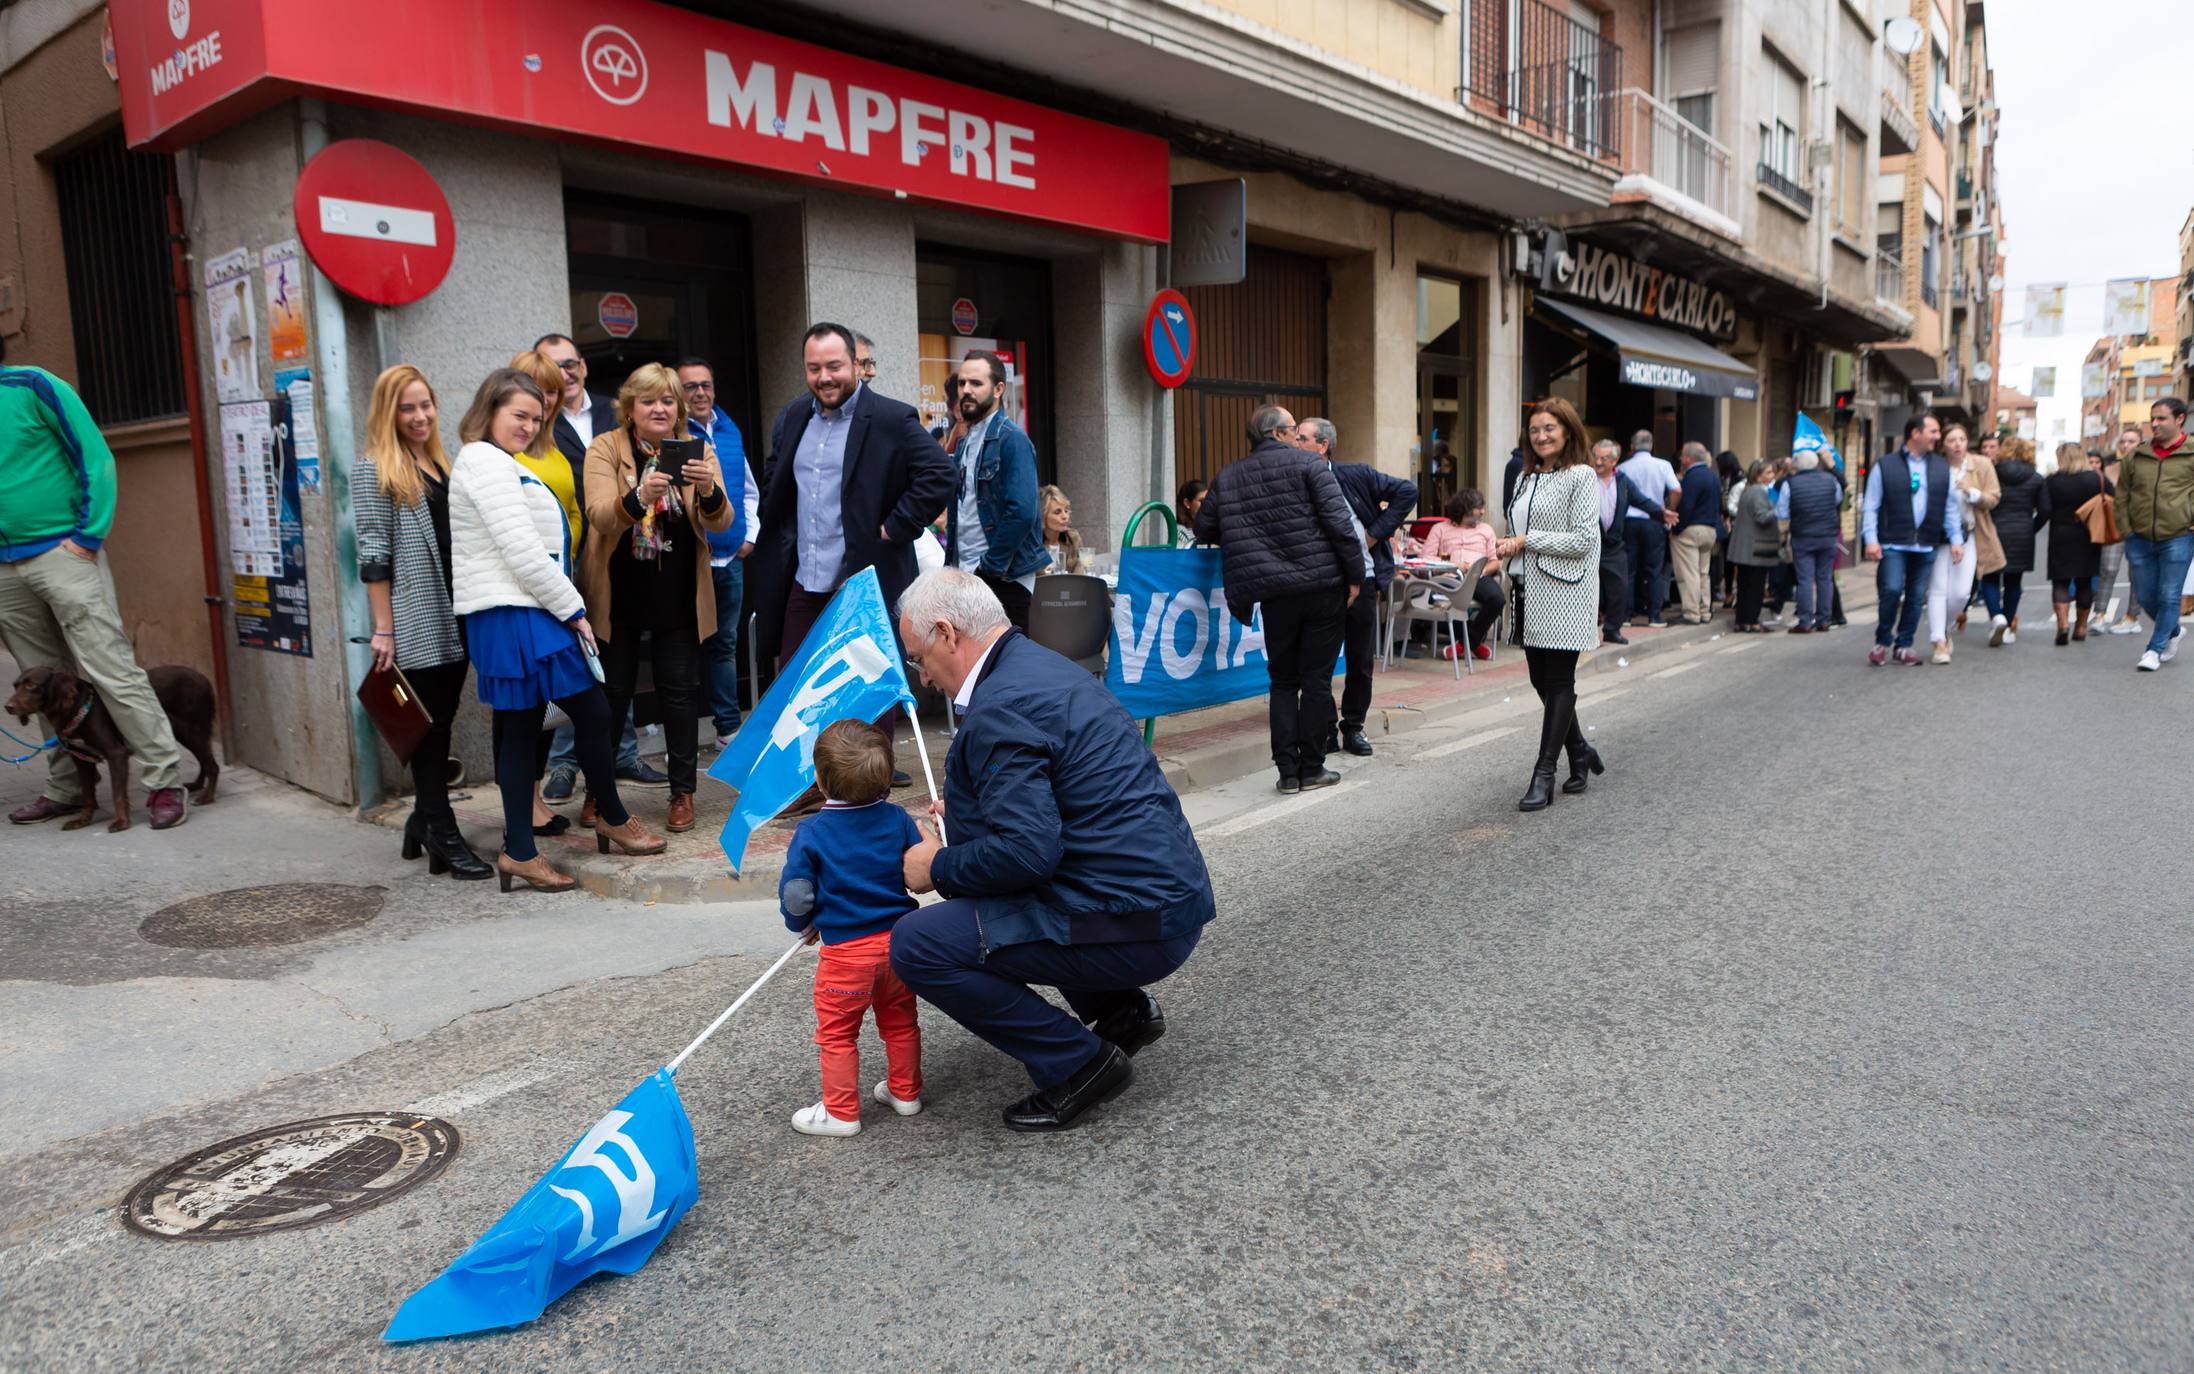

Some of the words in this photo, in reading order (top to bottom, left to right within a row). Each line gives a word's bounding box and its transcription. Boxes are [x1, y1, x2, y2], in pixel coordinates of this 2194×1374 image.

[150, 31, 223, 97] MAPFRE
[704, 49, 1037, 190] MAPFRE
[1569, 241, 1726, 334] MONTECARLO
[1630, 361, 1690, 389] MONTECARLO
[1113, 587, 1269, 684] VOTA
[195, 1126, 383, 1173] AYUNTAMIENTO
